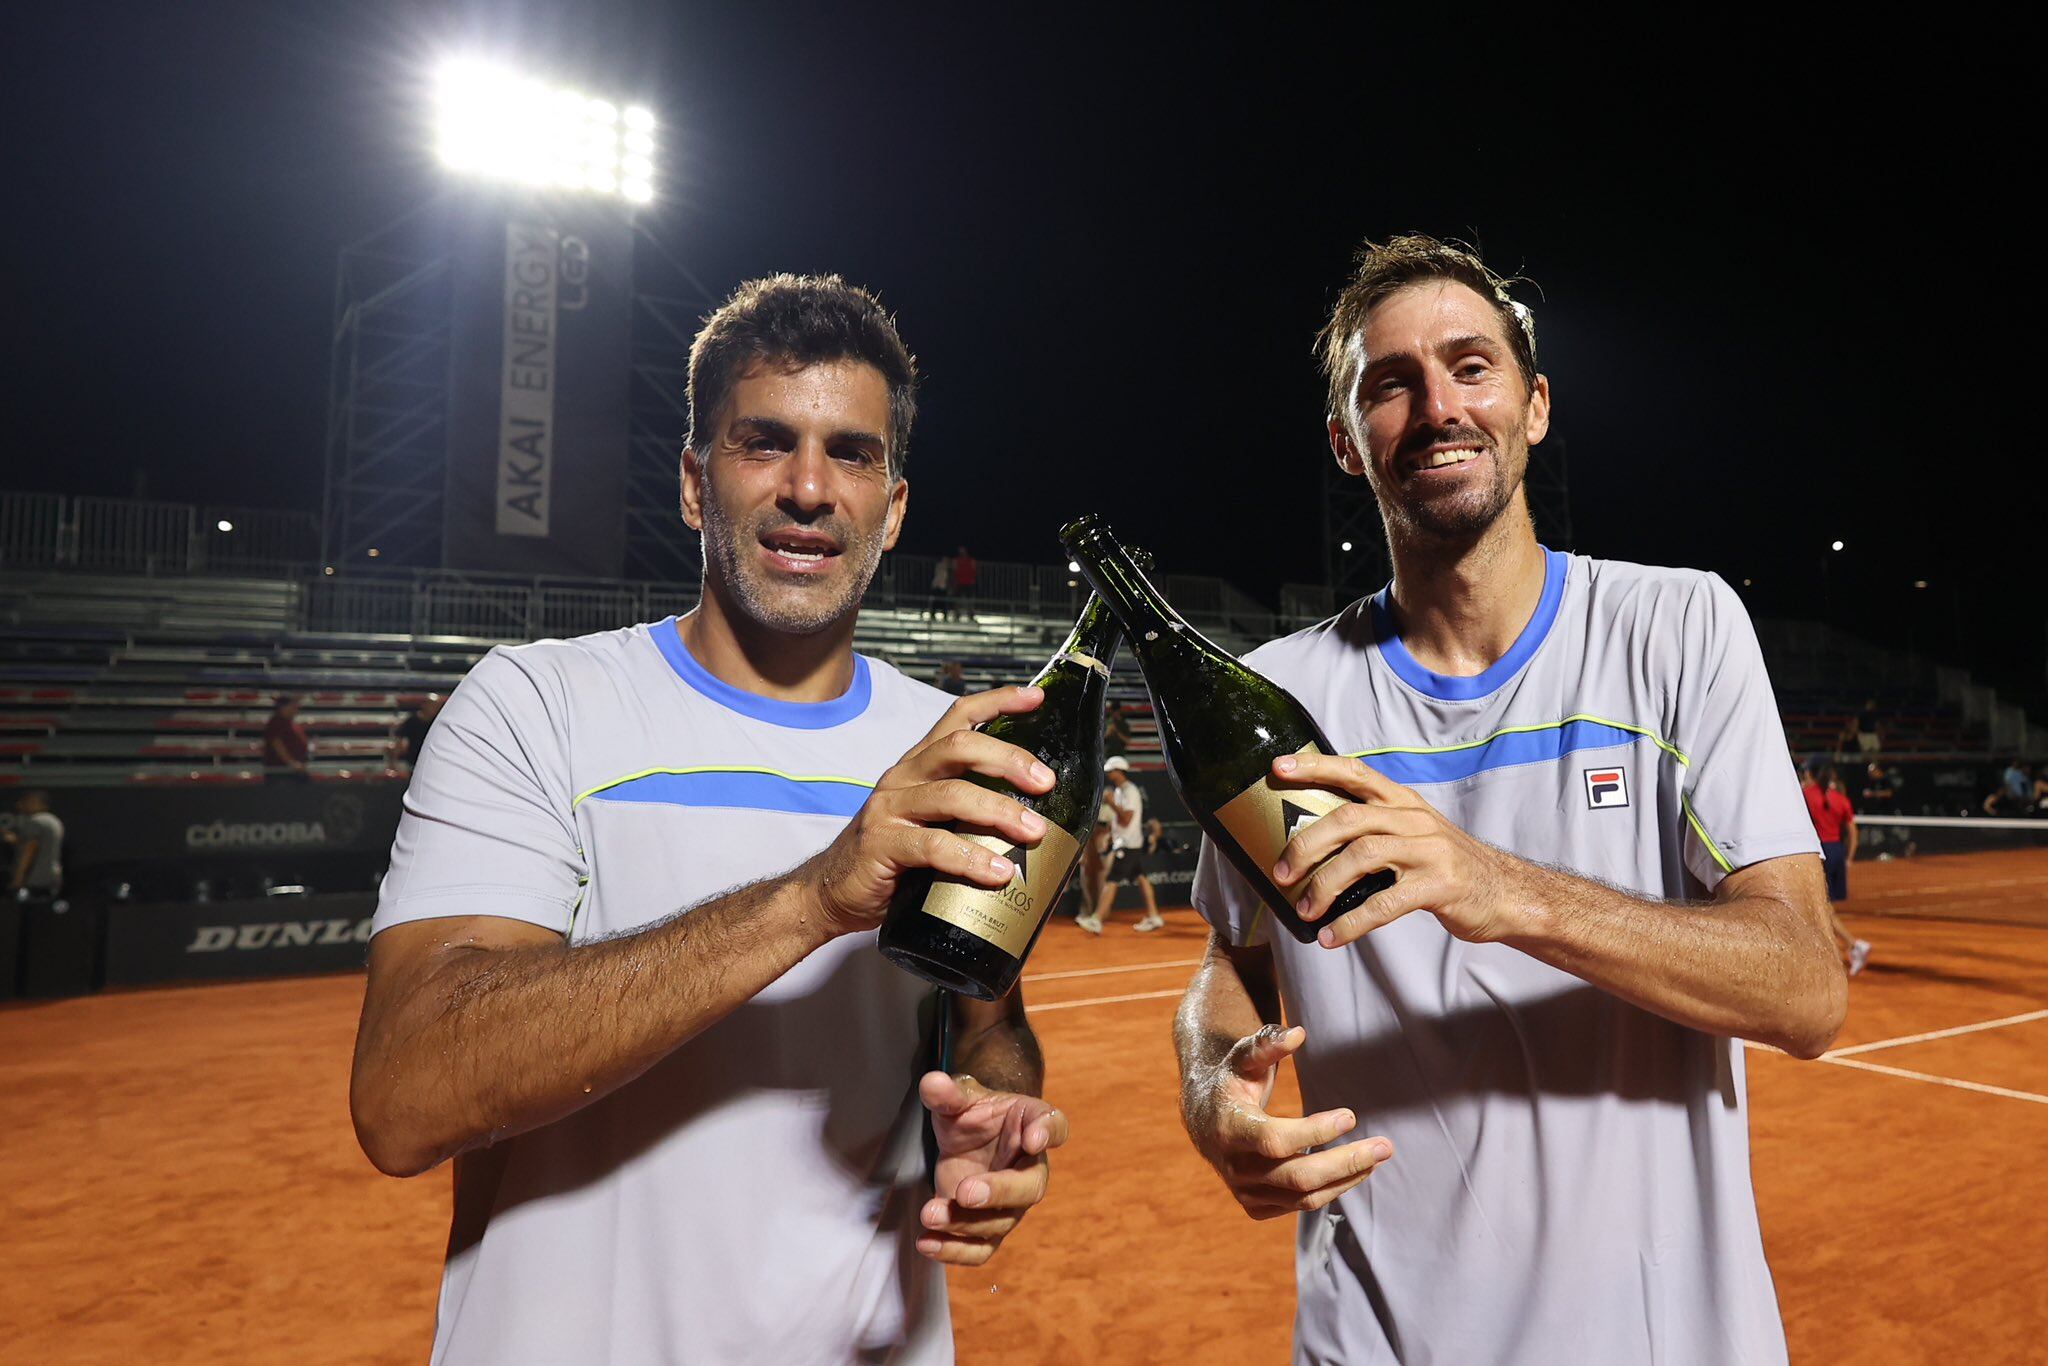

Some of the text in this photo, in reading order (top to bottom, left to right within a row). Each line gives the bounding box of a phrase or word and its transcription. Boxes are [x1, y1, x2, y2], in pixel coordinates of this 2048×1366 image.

[507, 232, 549, 520] AKAI ENERGY
[187, 819, 326, 846] CÓRDOBA
[997, 884, 1034, 911] MOS
[988, 916, 1005, 929] BRUT
